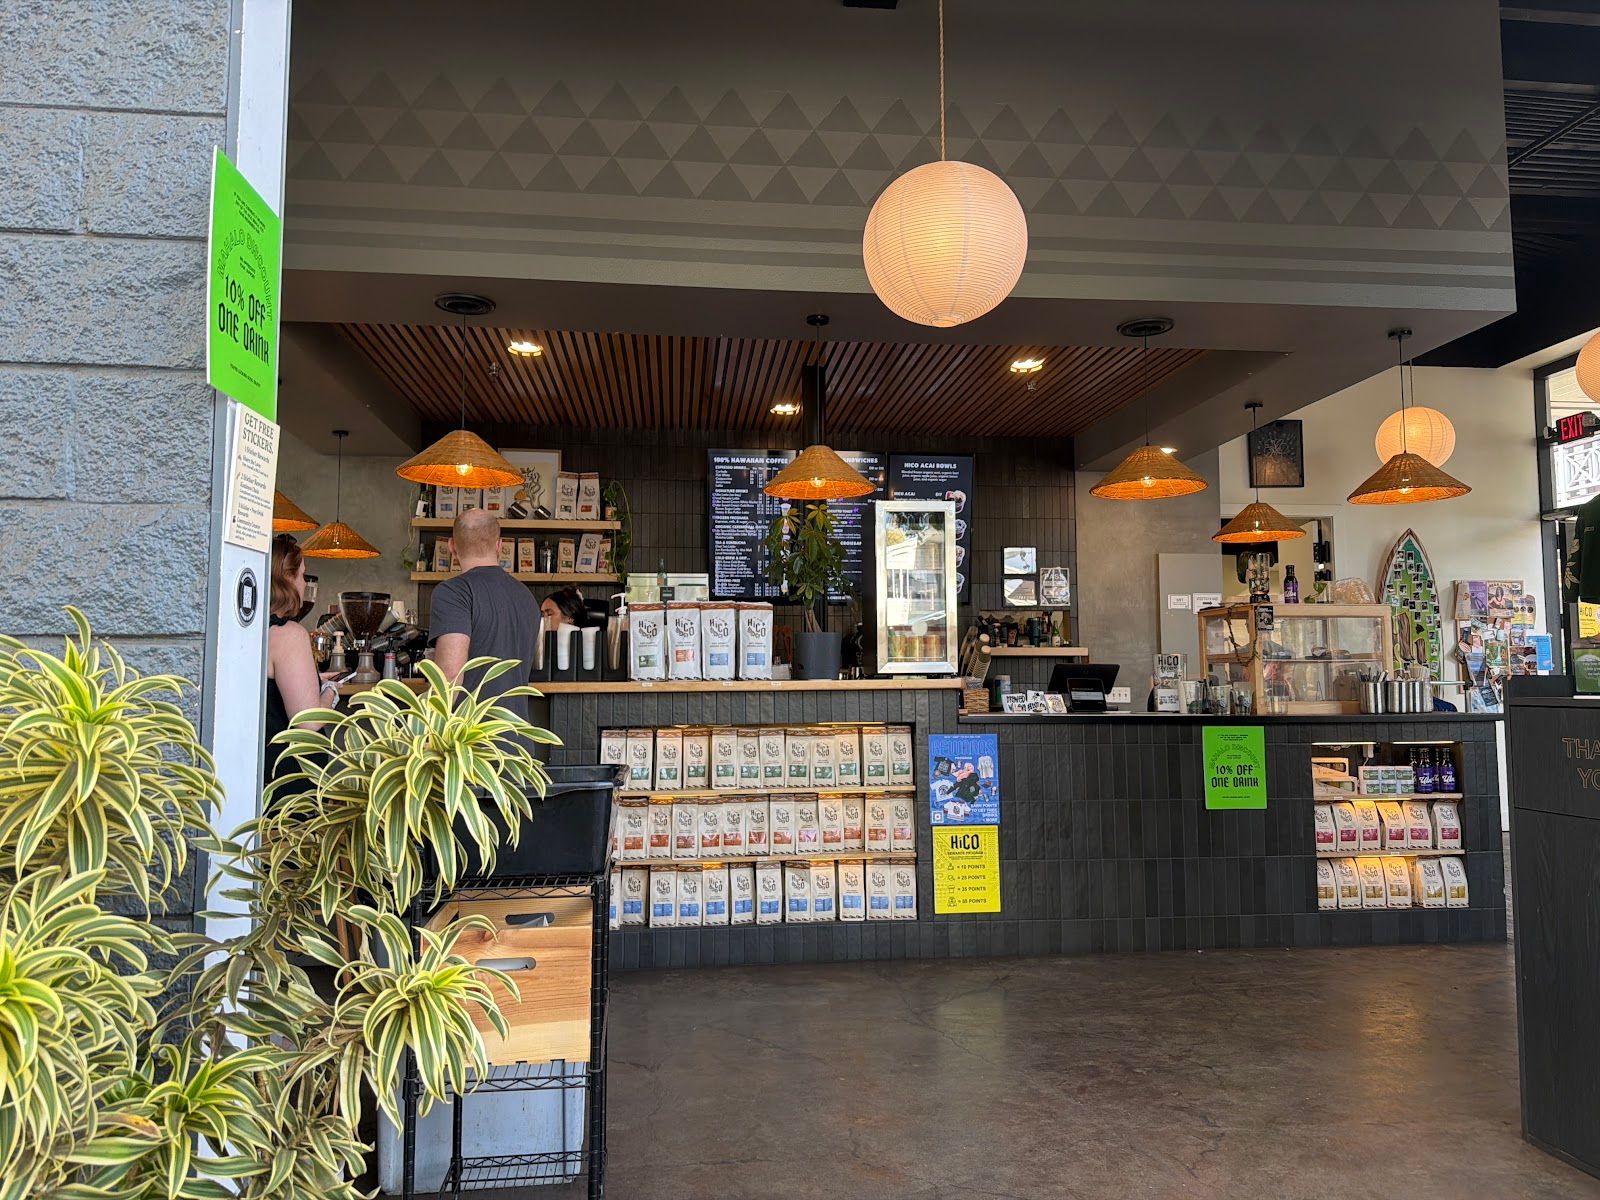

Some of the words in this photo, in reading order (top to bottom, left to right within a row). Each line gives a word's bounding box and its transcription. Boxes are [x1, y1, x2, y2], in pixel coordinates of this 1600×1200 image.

[225, 275, 245, 312] 10%
[248, 293, 266, 330] OFF
[218, 302, 239, 344] ONE
[243, 322, 269, 366] DRINK
[245, 413, 258, 431] GET
[259, 420, 274, 440] FREE
[1561, 414, 1583, 441] EXIT
[1212, 777, 1229, 788] ONE
[1233, 777, 1259, 788] DRINK
[1216, 765, 1233, 774] 10%
[1236, 765, 1253, 775] OFF
[951, 834, 979, 850] HiCO
